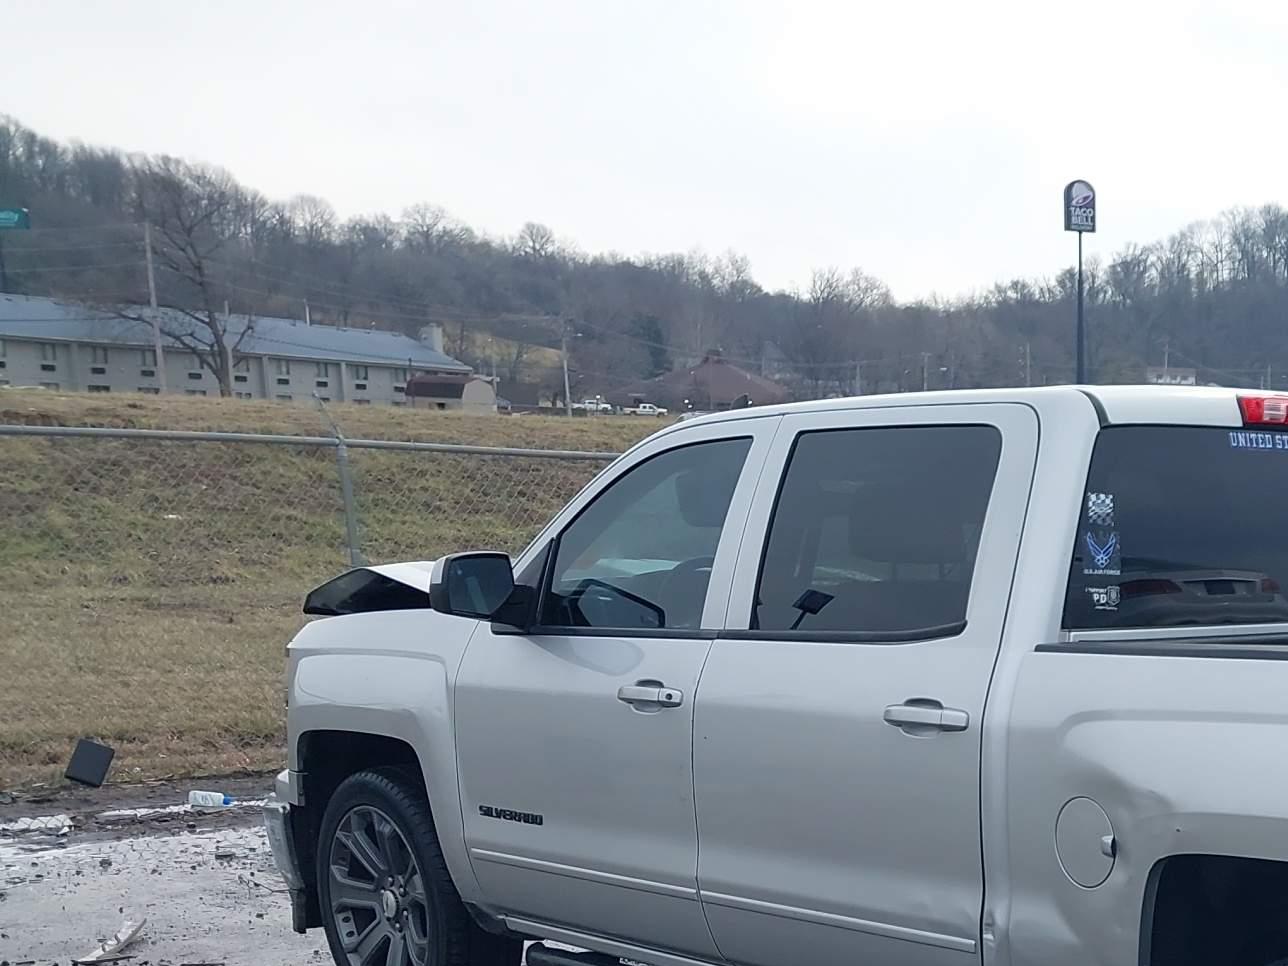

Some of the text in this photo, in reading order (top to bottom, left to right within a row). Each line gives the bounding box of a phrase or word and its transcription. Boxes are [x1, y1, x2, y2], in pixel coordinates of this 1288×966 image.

[1069, 207, 1094, 217] TACO
[1229, 431, 1273, 449] UNITED
[479, 805, 543, 826] SILVERADO
